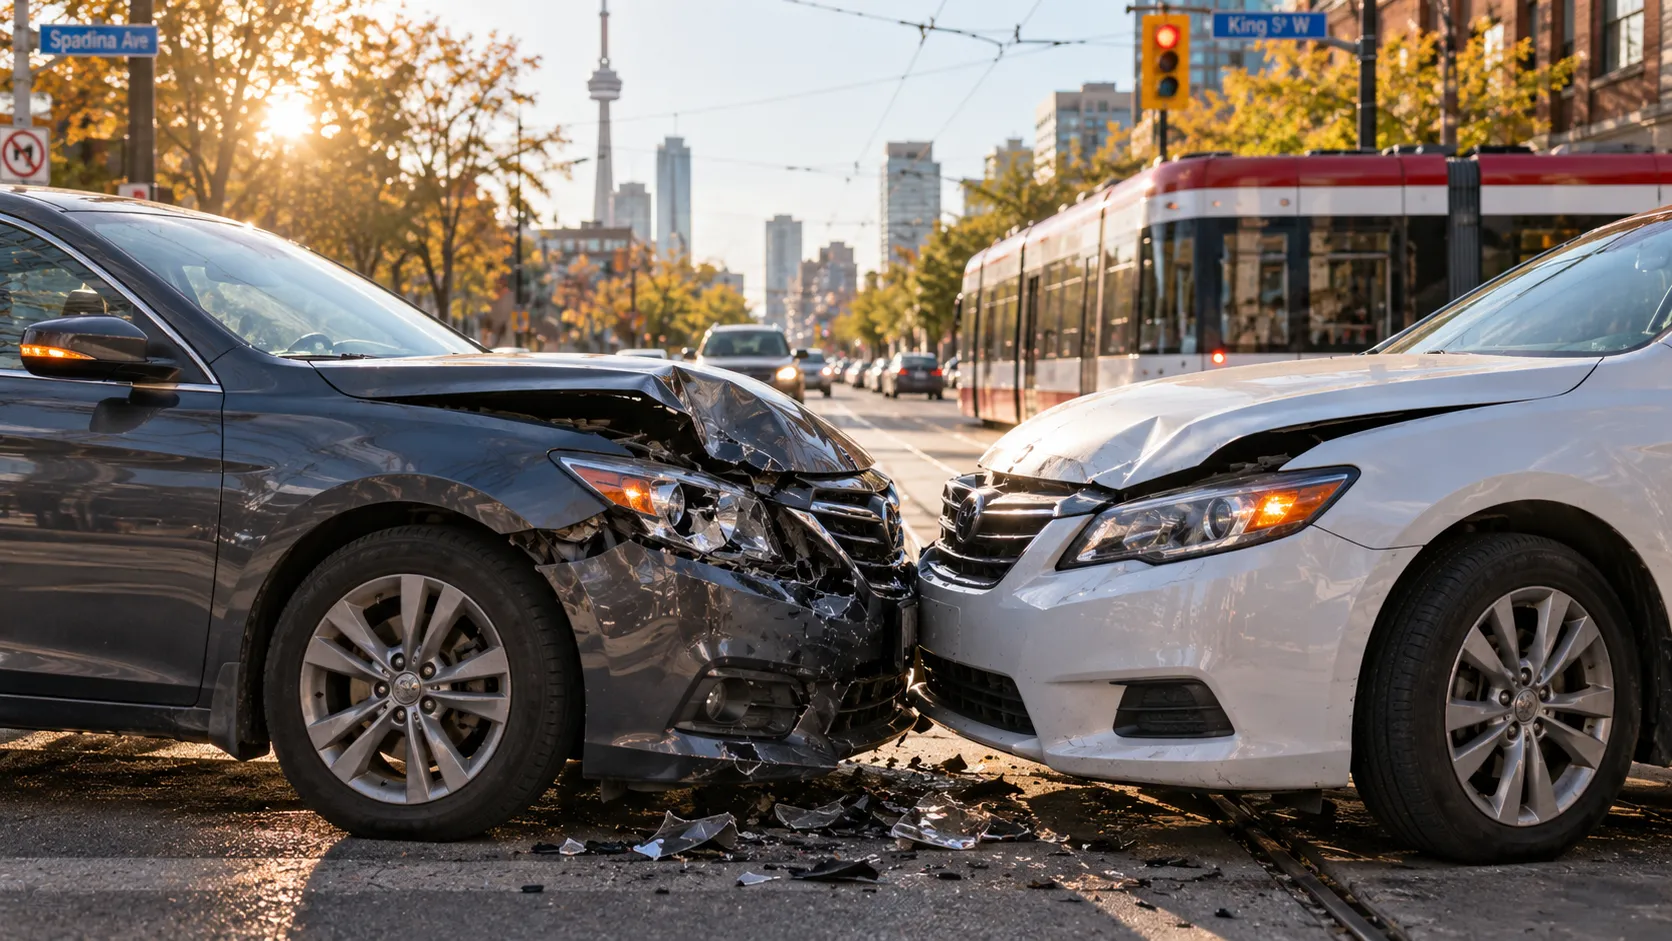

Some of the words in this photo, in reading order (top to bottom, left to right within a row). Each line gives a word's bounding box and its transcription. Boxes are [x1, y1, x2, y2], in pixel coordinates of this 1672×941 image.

[1228, 15, 1268, 38] King
[1271, 16, 1288, 34] St
[1292, 16, 1311, 34] W
[50, 29, 116, 53] Spadina
[121, 31, 149, 49] Ave
